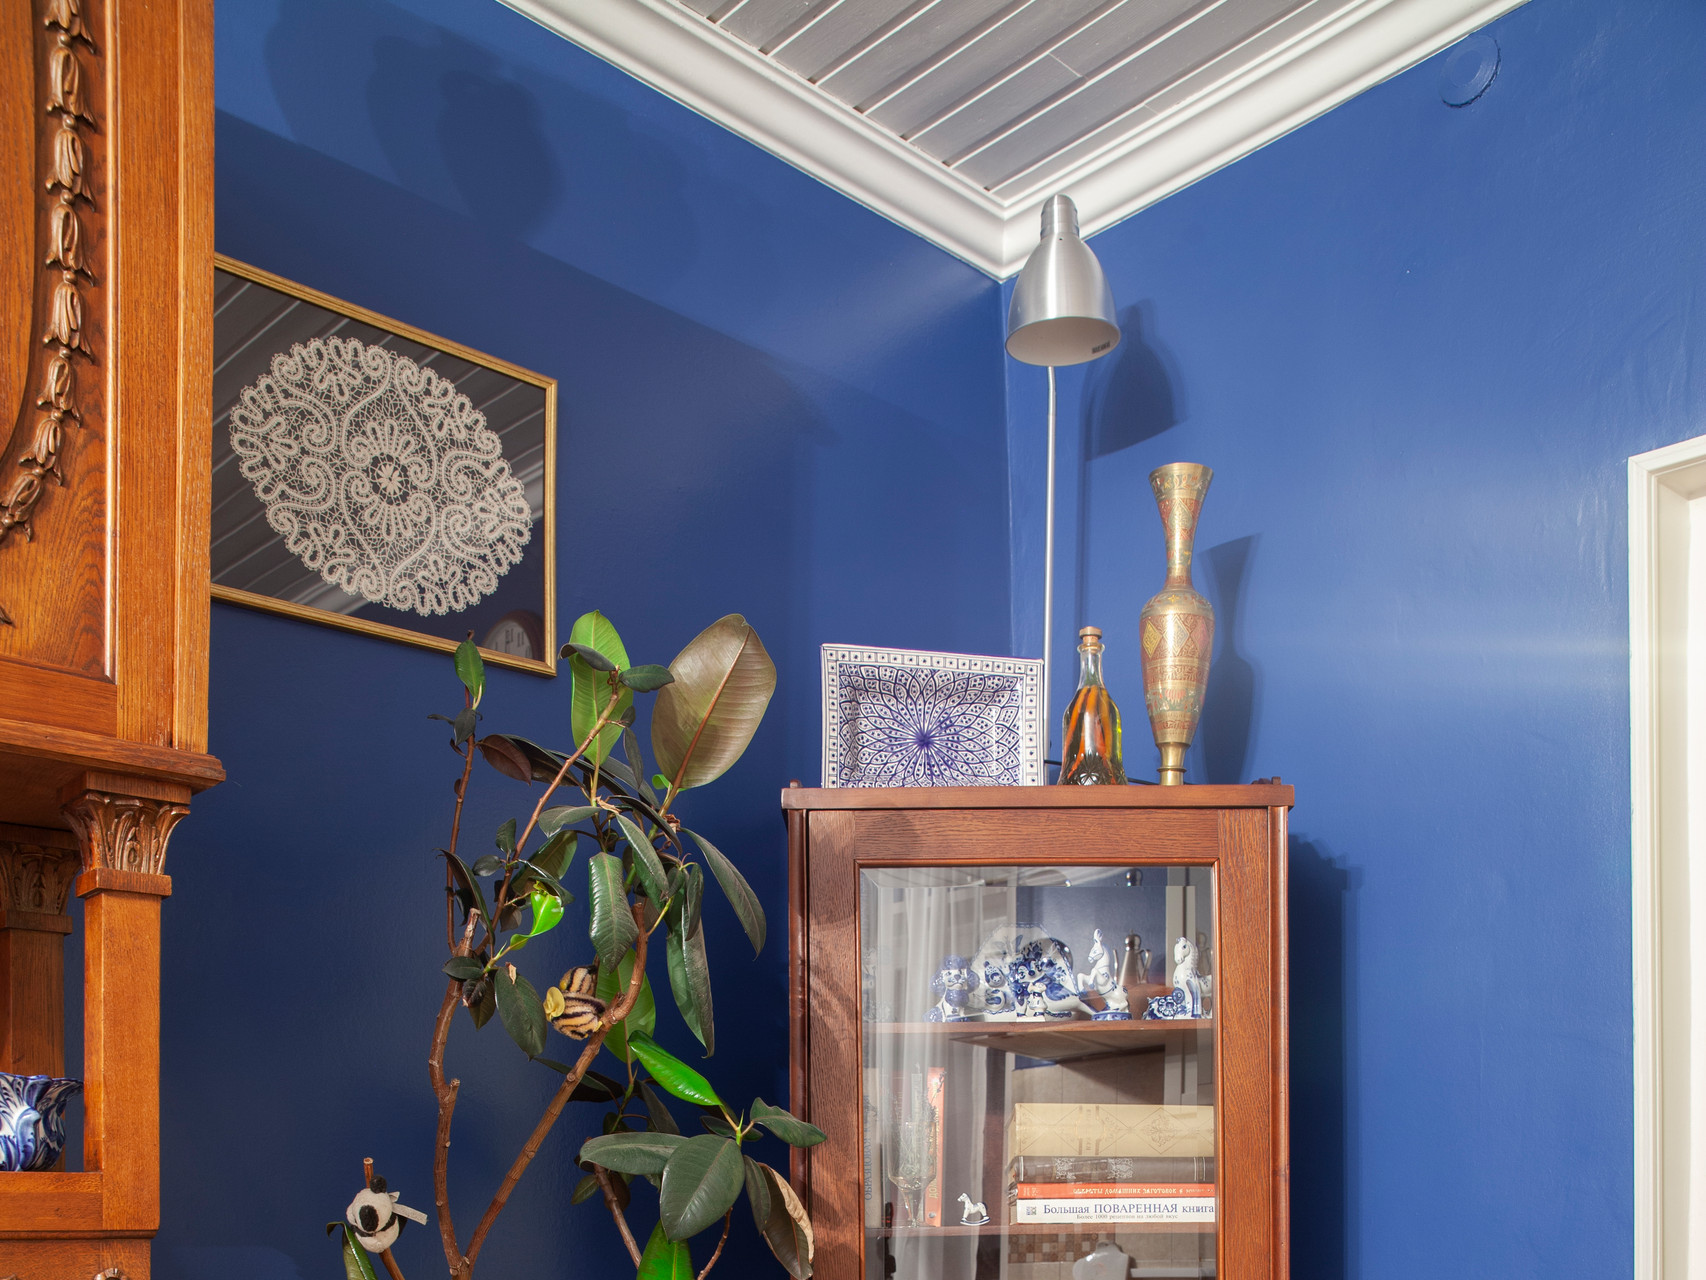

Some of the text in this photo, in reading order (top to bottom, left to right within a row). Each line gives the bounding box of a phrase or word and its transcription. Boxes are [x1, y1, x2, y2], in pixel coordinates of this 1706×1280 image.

[1043, 1204, 1090, 1214] Большая
[1094, 1203, 1178, 1213] ПОВАРЕННАЯ
[1182, 1205, 1214, 1214] книга
